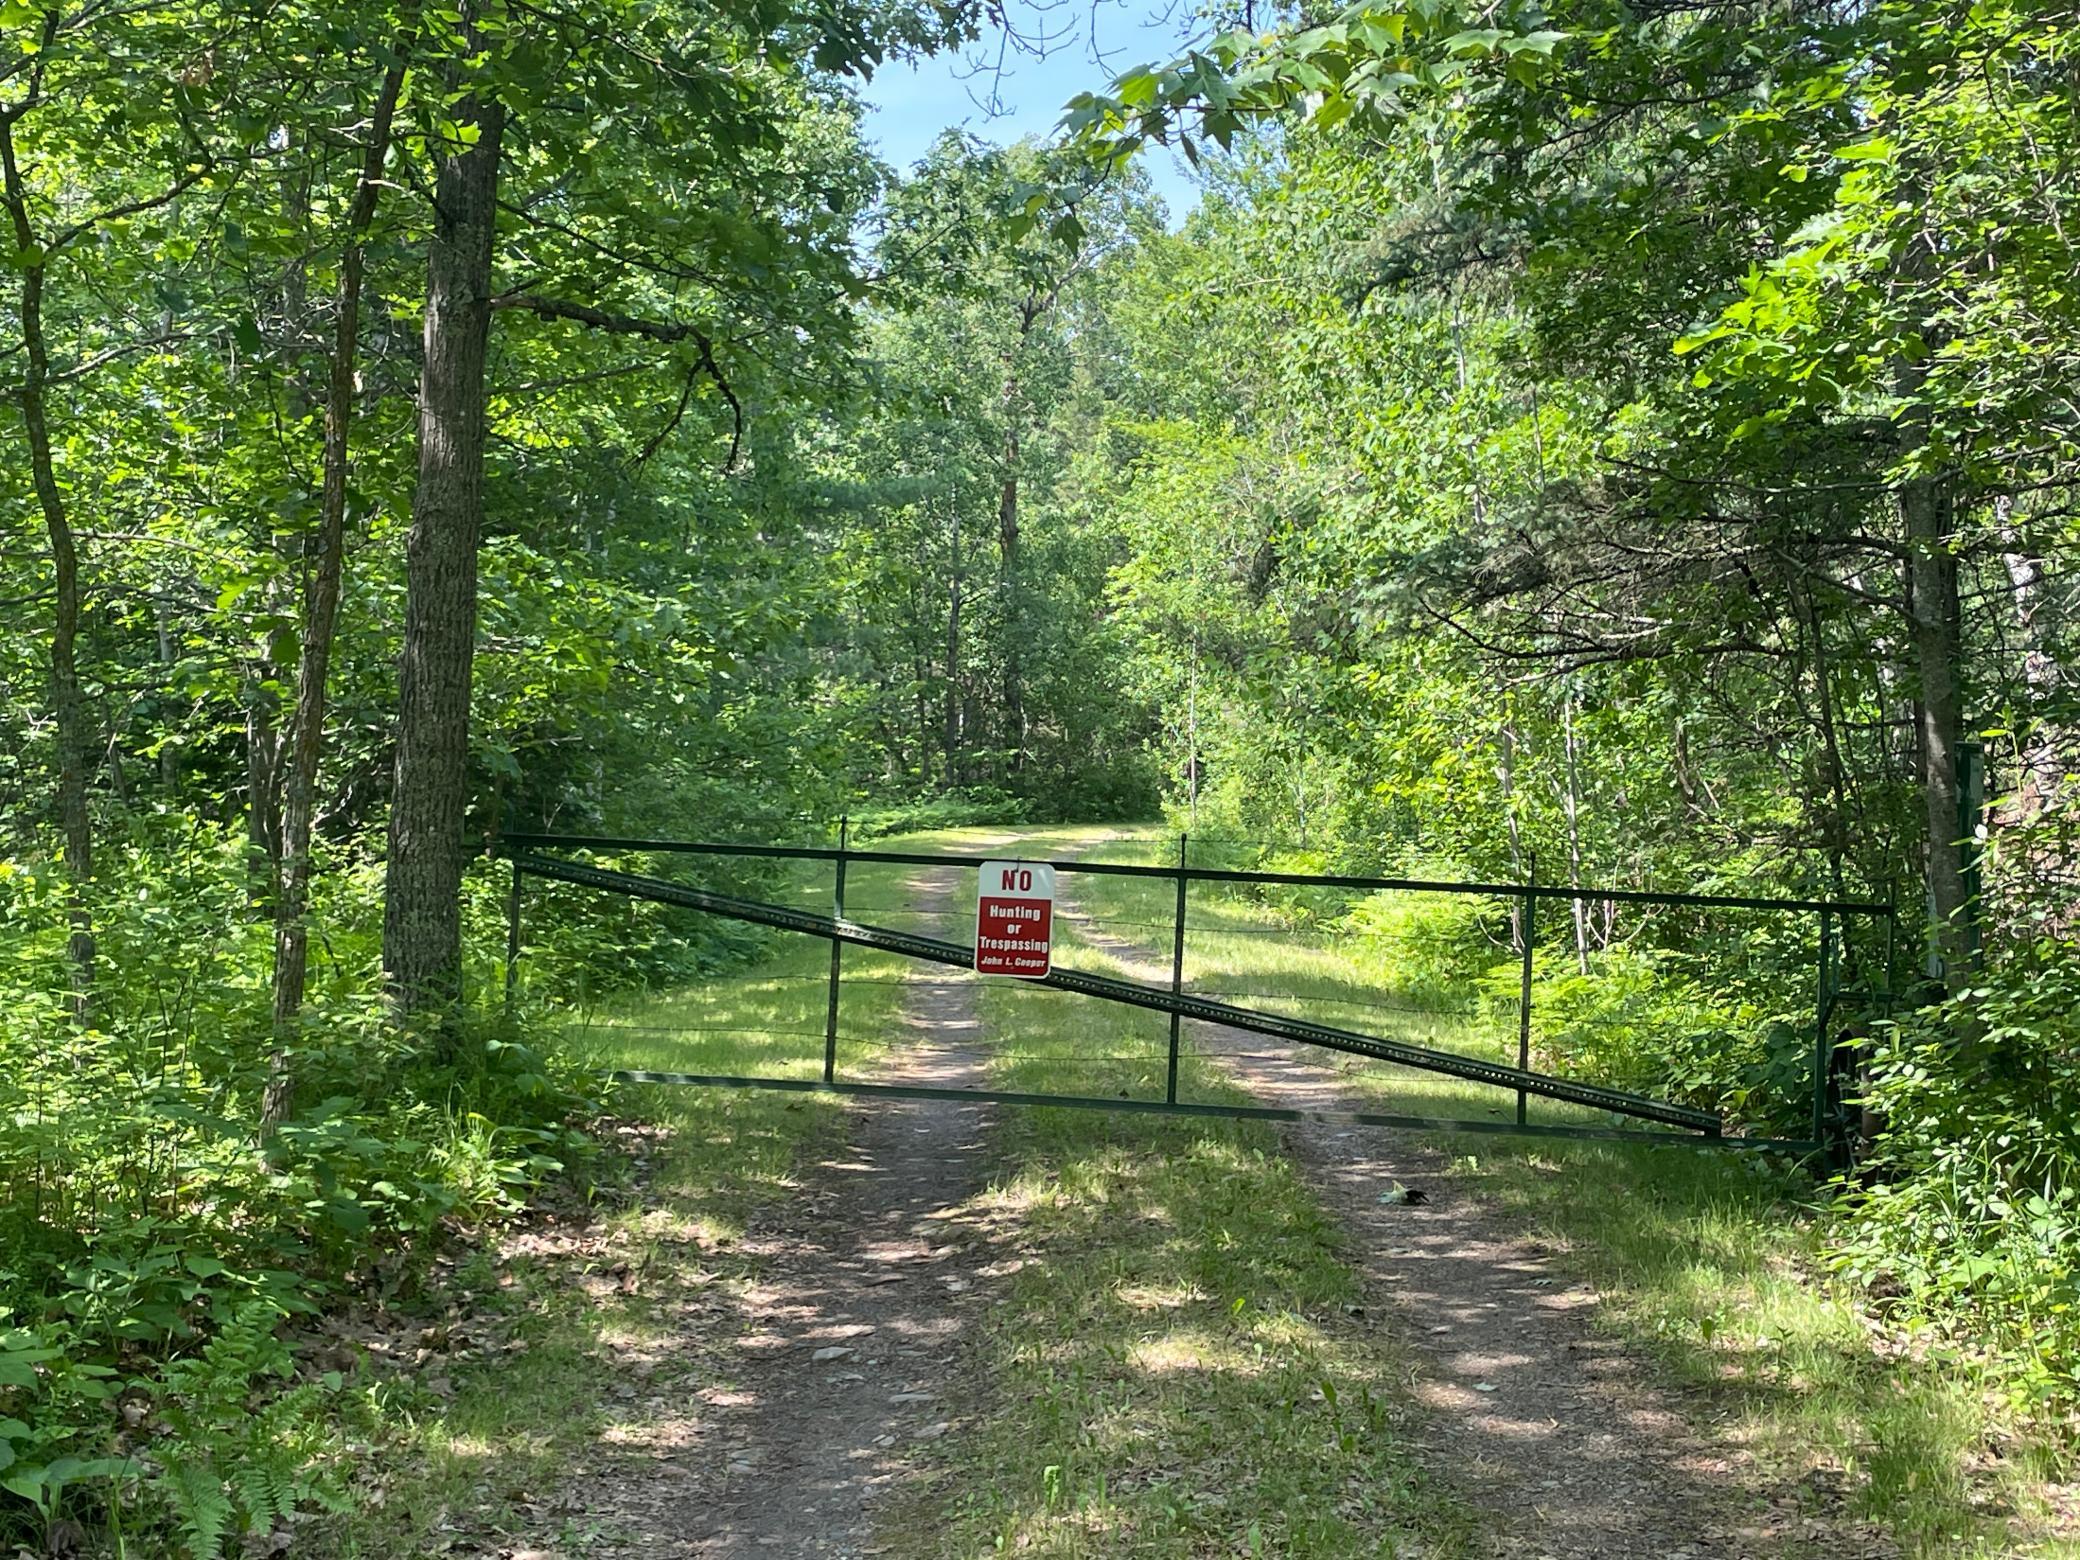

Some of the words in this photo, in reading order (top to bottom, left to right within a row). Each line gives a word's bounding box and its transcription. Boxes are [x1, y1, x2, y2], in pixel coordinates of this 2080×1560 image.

[1002, 870, 1032, 891] NO
[990, 905, 1040, 921] Hunting
[1007, 924, 1022, 934] or
[980, 936, 1048, 952] Trespassing
[981, 956, 1002, 966] John
[1006, 956, 1014, 966] L.
